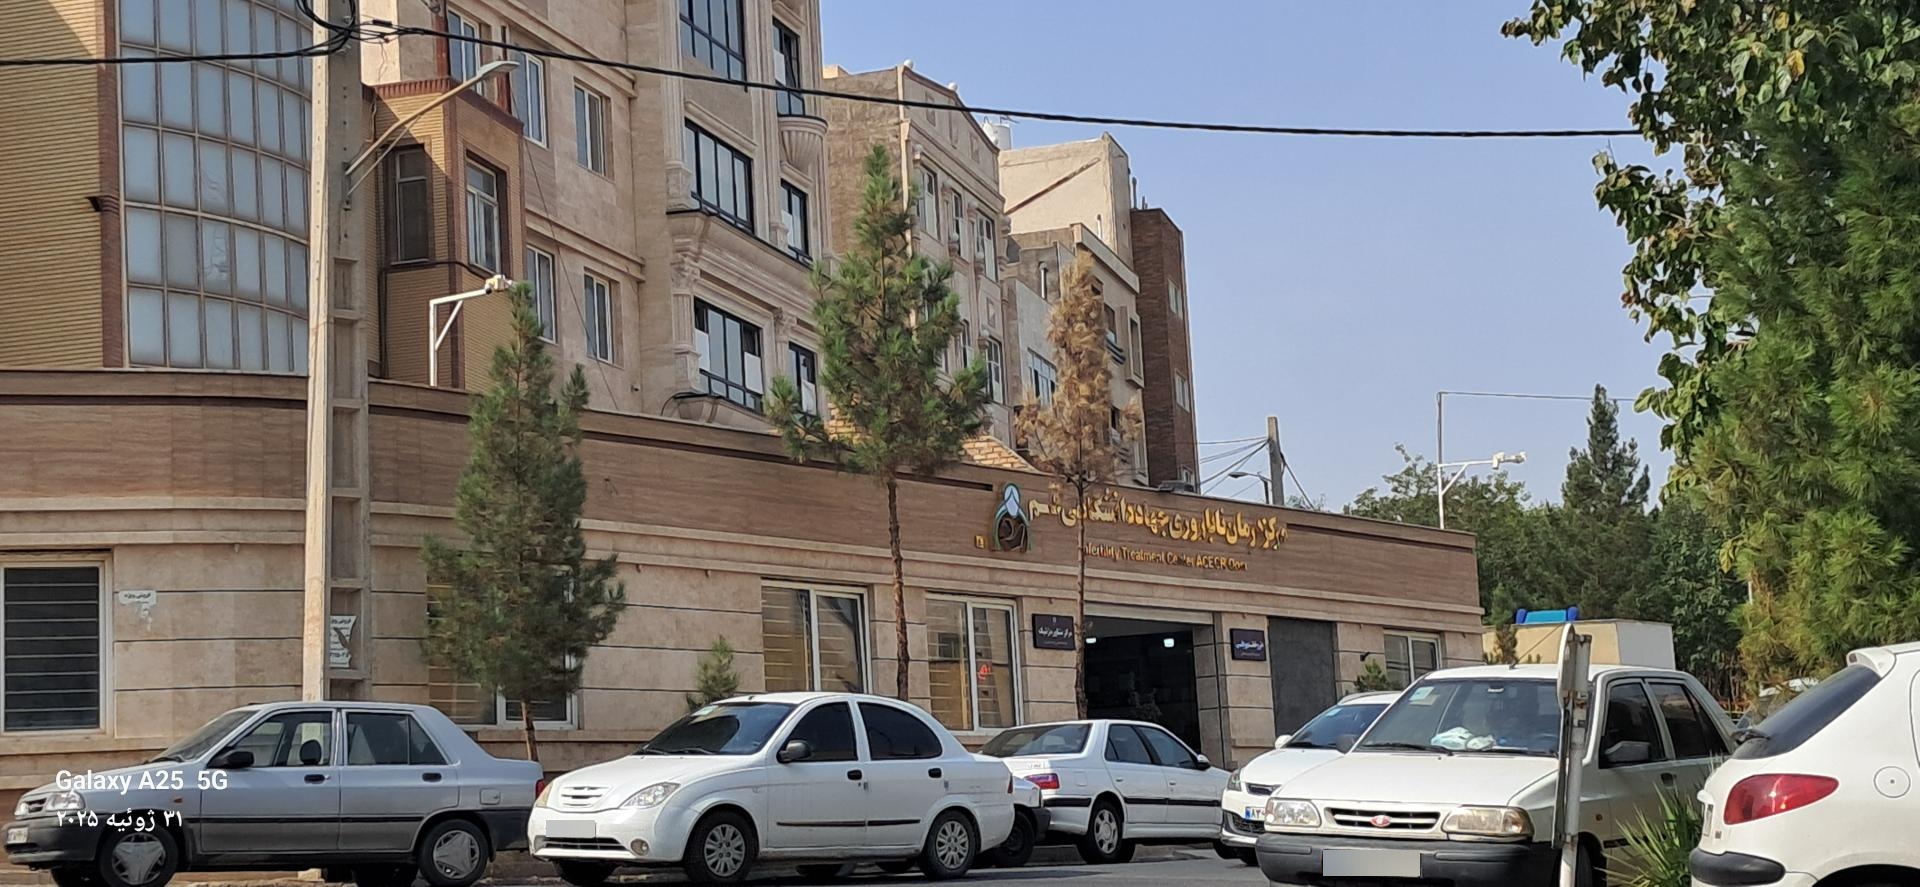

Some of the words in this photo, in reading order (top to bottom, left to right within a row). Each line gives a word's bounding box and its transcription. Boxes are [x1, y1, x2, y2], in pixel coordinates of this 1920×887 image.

[1135, 501, 1169, 537] جهاد
[1169, 507, 1226, 543] ناباروری
[1264, 516, 1287, 549] مرکز
[1081, 541, 1119, 560] nfertility
[1121, 545, 1165, 563] Treatment
[1195, 554, 1227, 571] ACECR
